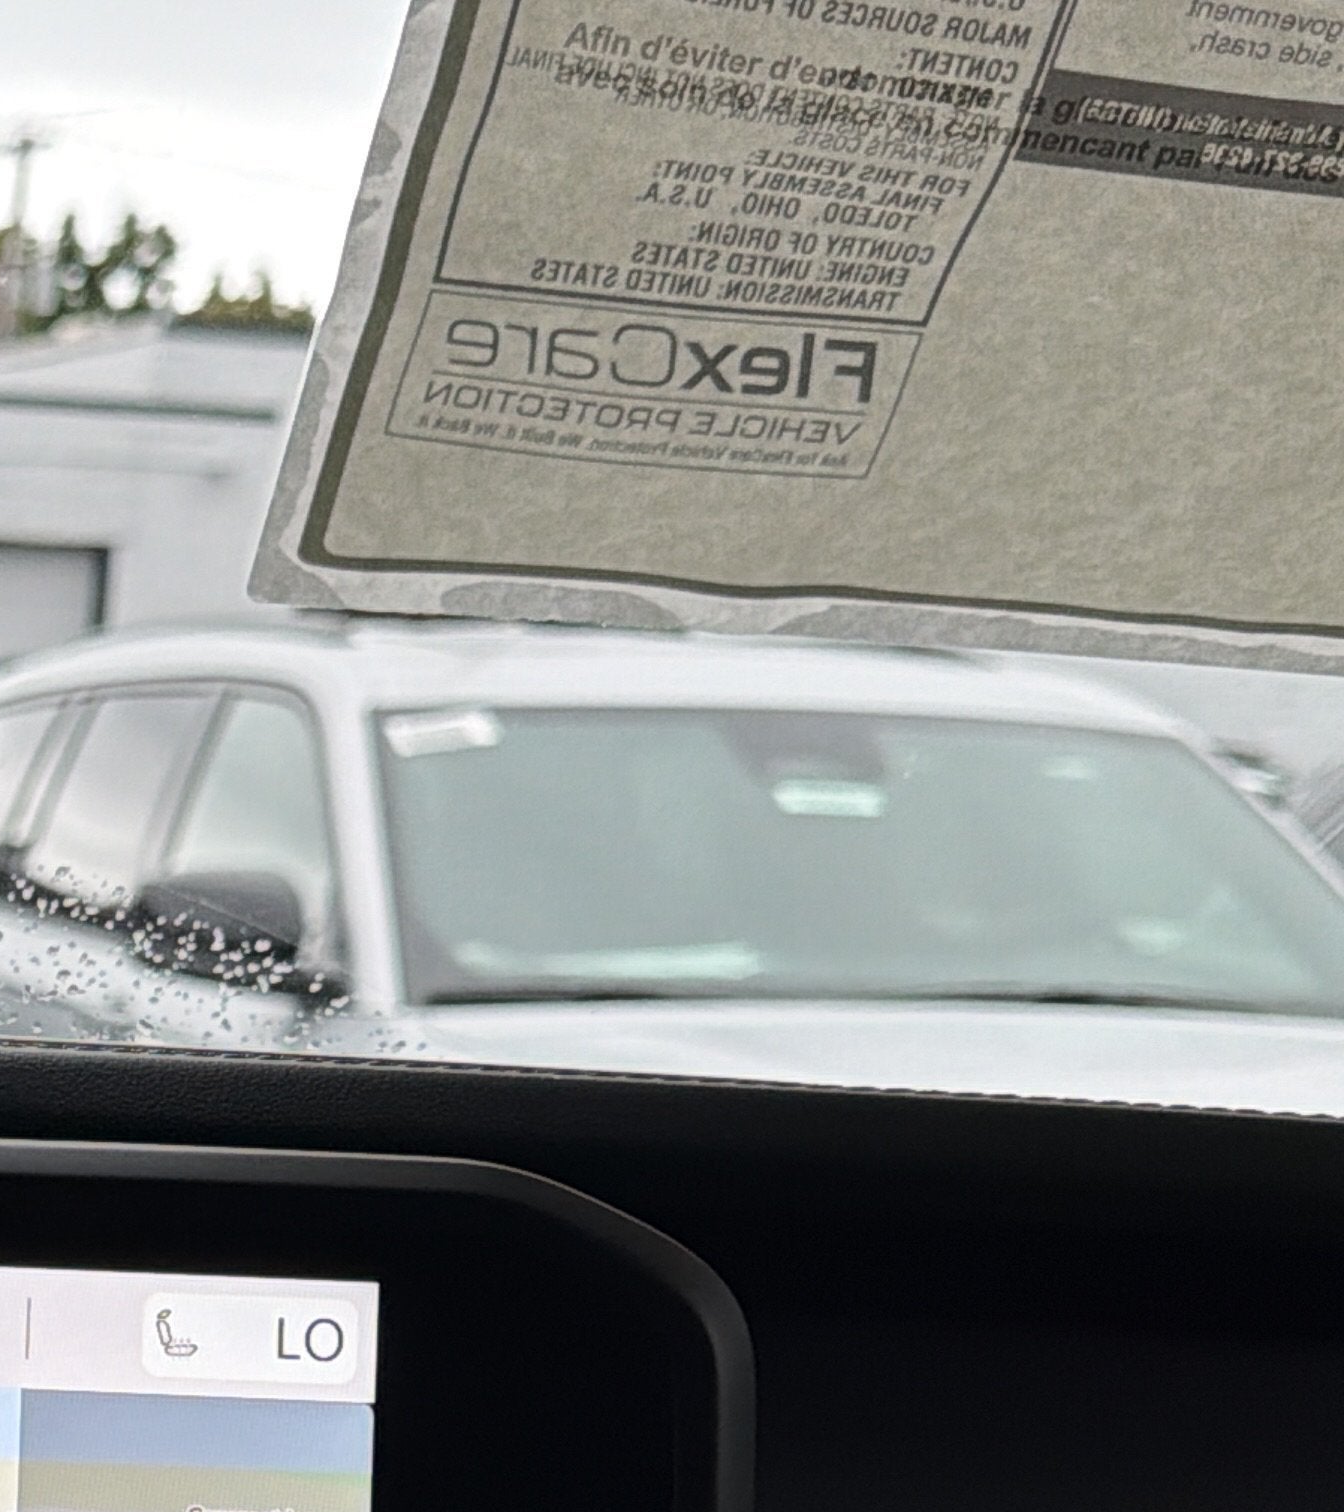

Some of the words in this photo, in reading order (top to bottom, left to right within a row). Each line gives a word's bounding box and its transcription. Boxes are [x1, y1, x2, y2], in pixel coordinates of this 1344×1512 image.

[563, 22, 631, 57] Afin
[641, 35, 764, 76] d'éviter
[277, 1317, 344, 1362] LO
